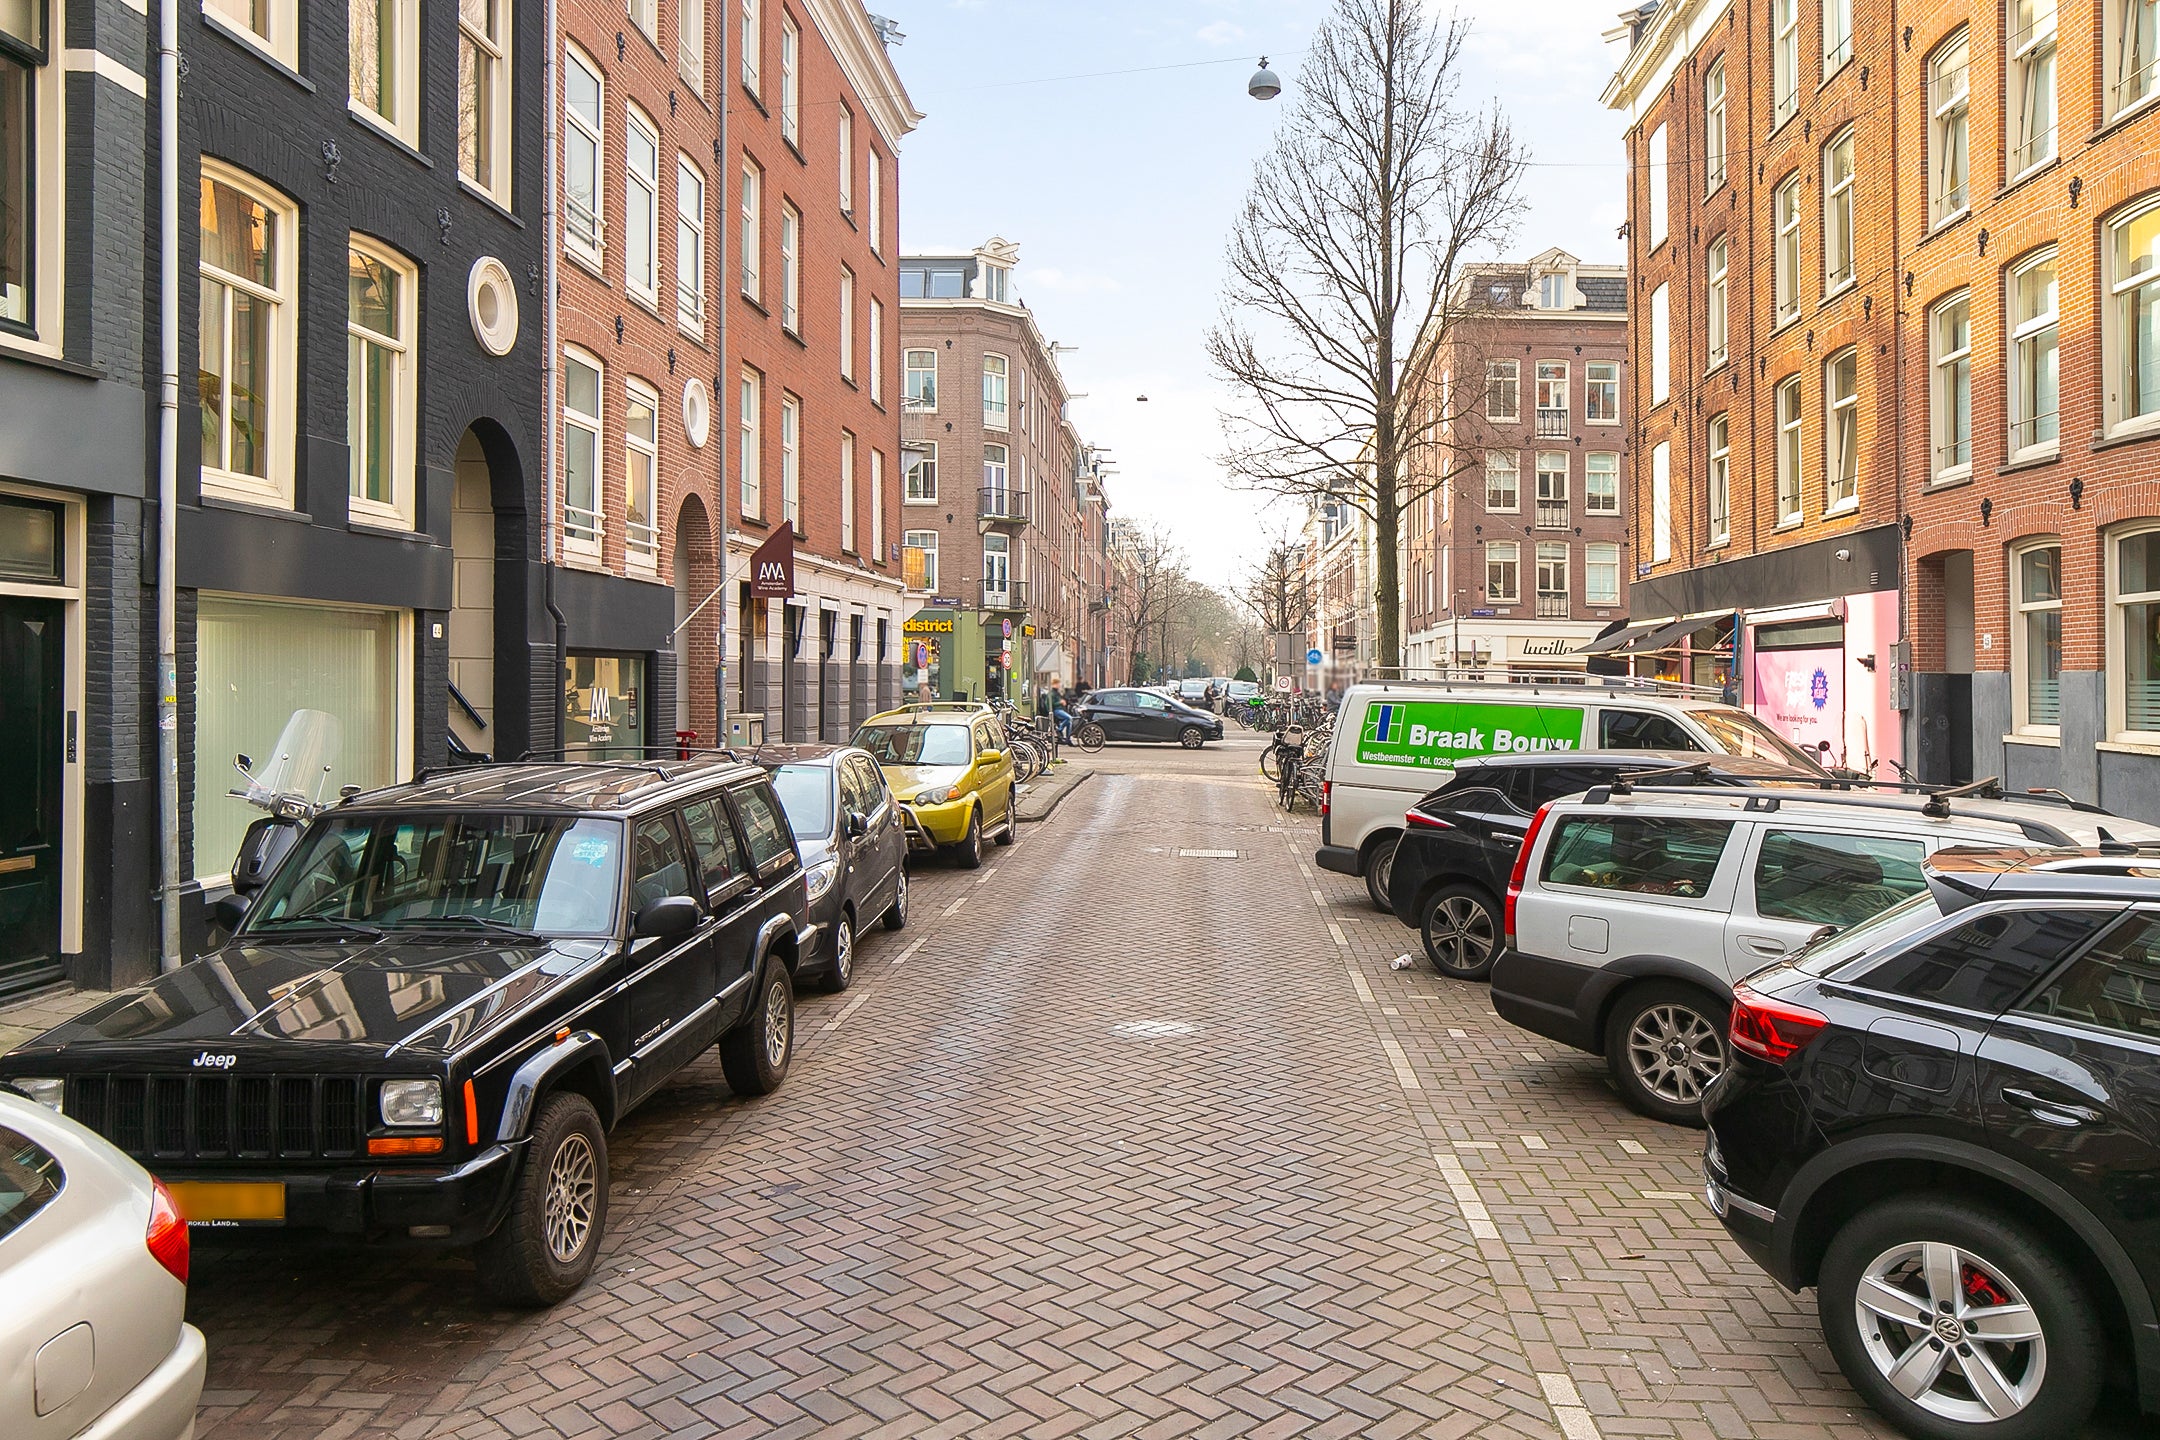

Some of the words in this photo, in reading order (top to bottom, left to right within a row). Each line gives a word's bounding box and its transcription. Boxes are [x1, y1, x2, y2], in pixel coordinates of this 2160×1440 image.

[903, 619, 953, 632] district
[1789, 713, 1803, 724] looking
[1408, 724, 1486, 750] Braak
[1493, 729, 1573, 752] Bouw
[1362, 751, 1416, 764] Westbeemster
[1419, 755, 1433, 765] Tel.
[1433, 757, 1456, 767] 0299-
[192, 1051, 237, 1070] Jeep
